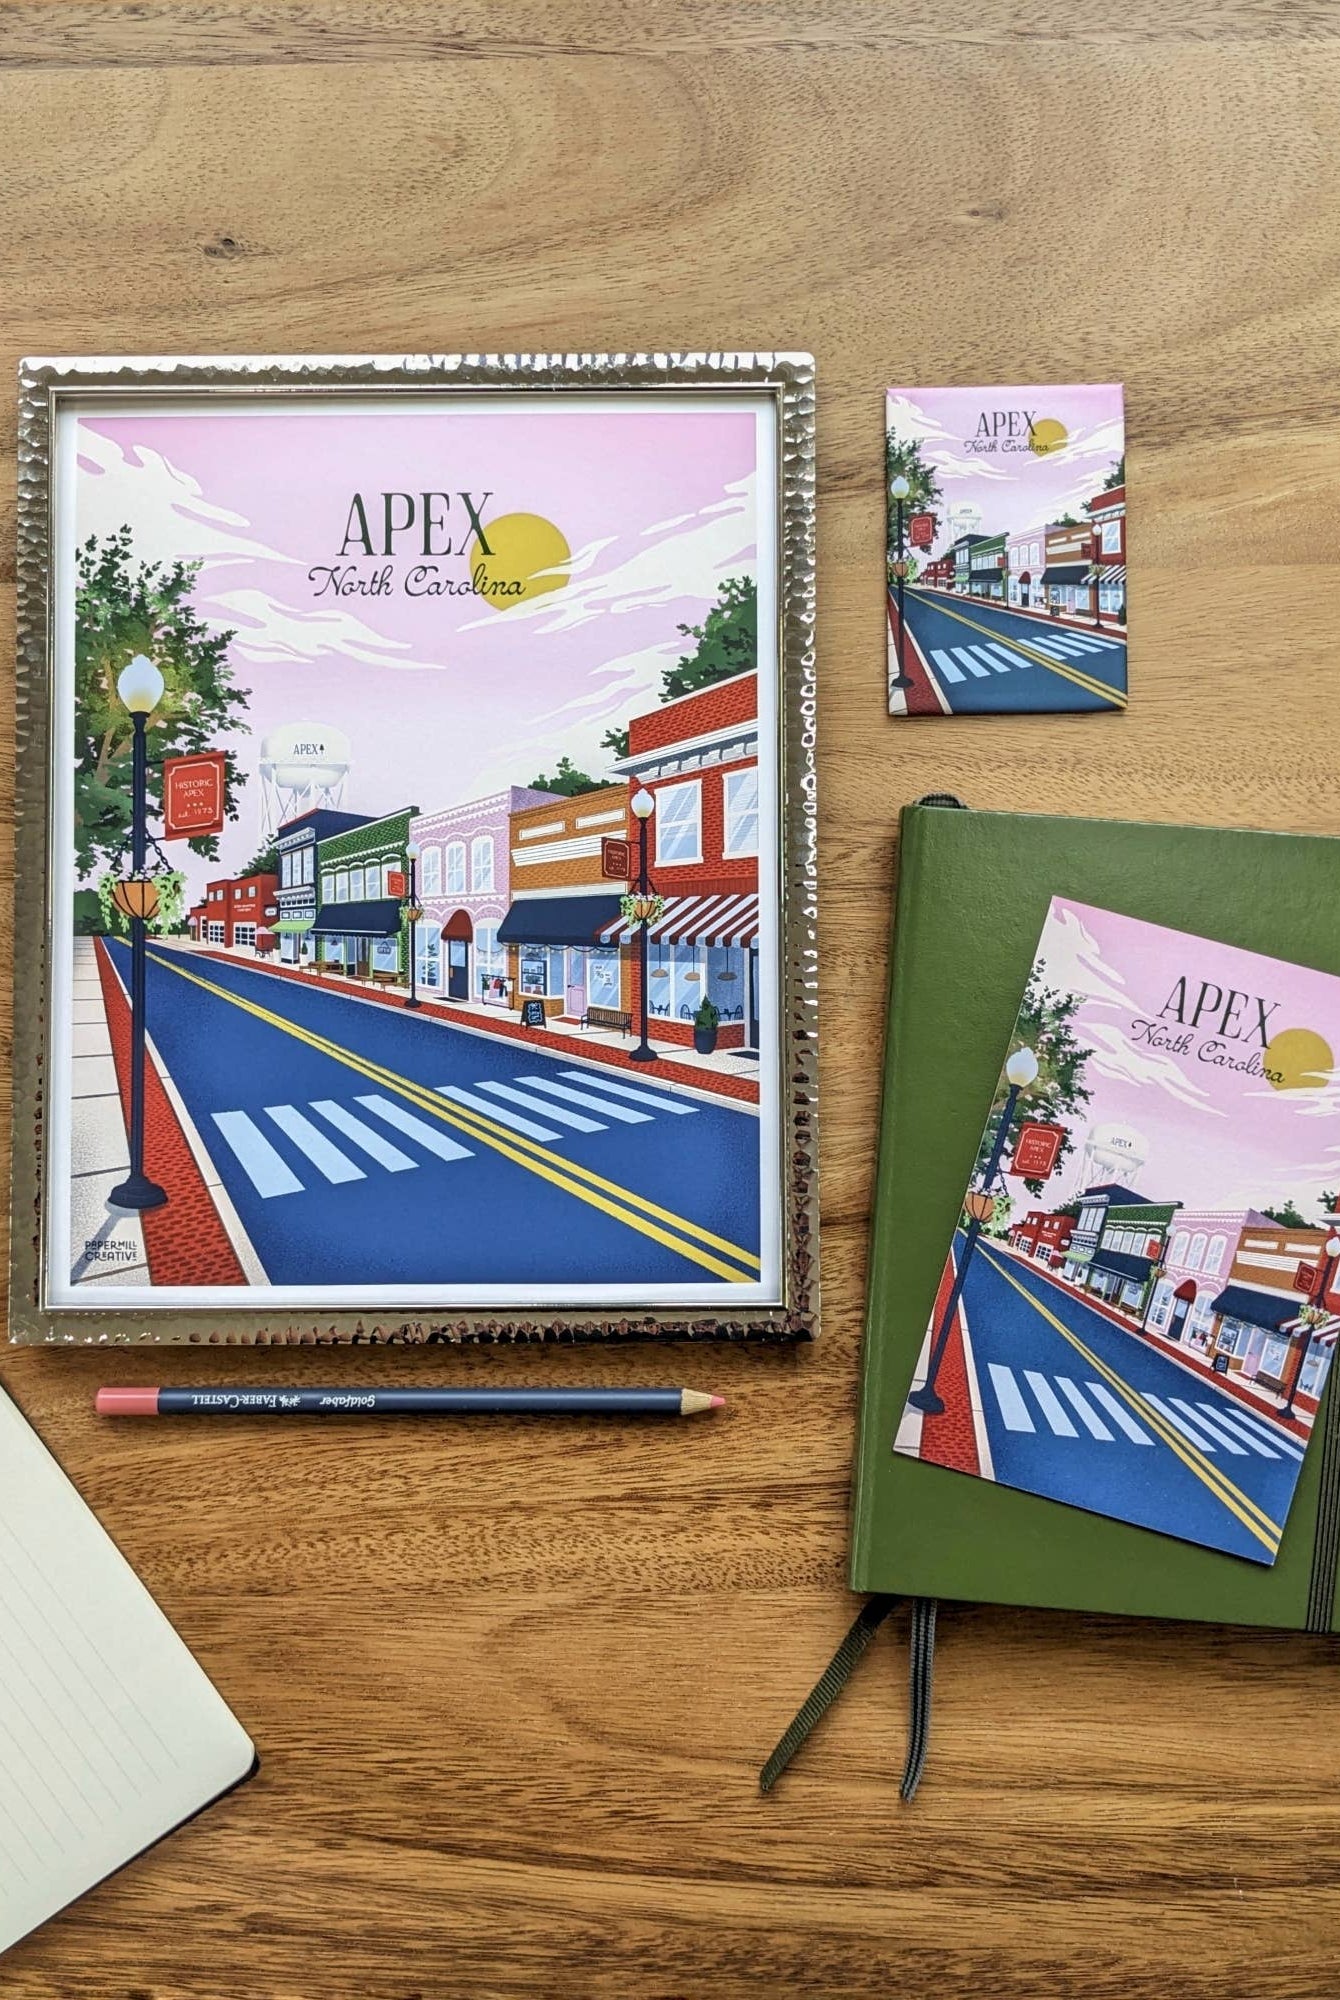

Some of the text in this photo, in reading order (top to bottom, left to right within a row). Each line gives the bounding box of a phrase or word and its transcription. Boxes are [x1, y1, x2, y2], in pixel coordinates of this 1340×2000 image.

[975, 411, 1037, 437] APEX
[964, 439, 1050, 453] North Carolina
[335, 492, 496, 556] APEX
[308, 563, 526, 597] North Carolina
[293, 743, 318, 755] APEX
[175, 778, 213, 790] HISTORIC
[183, 788, 205, 799] APEX
[1156, 975, 1281, 1050] APEX
[1131, 1019, 1285, 1083] North Carolina
[85, 1240, 137, 1250] PAPERMILL
[85, 1251, 137, 1261] CREATIVE
[192, 1394, 277, 1408] FABER-CASTELL
